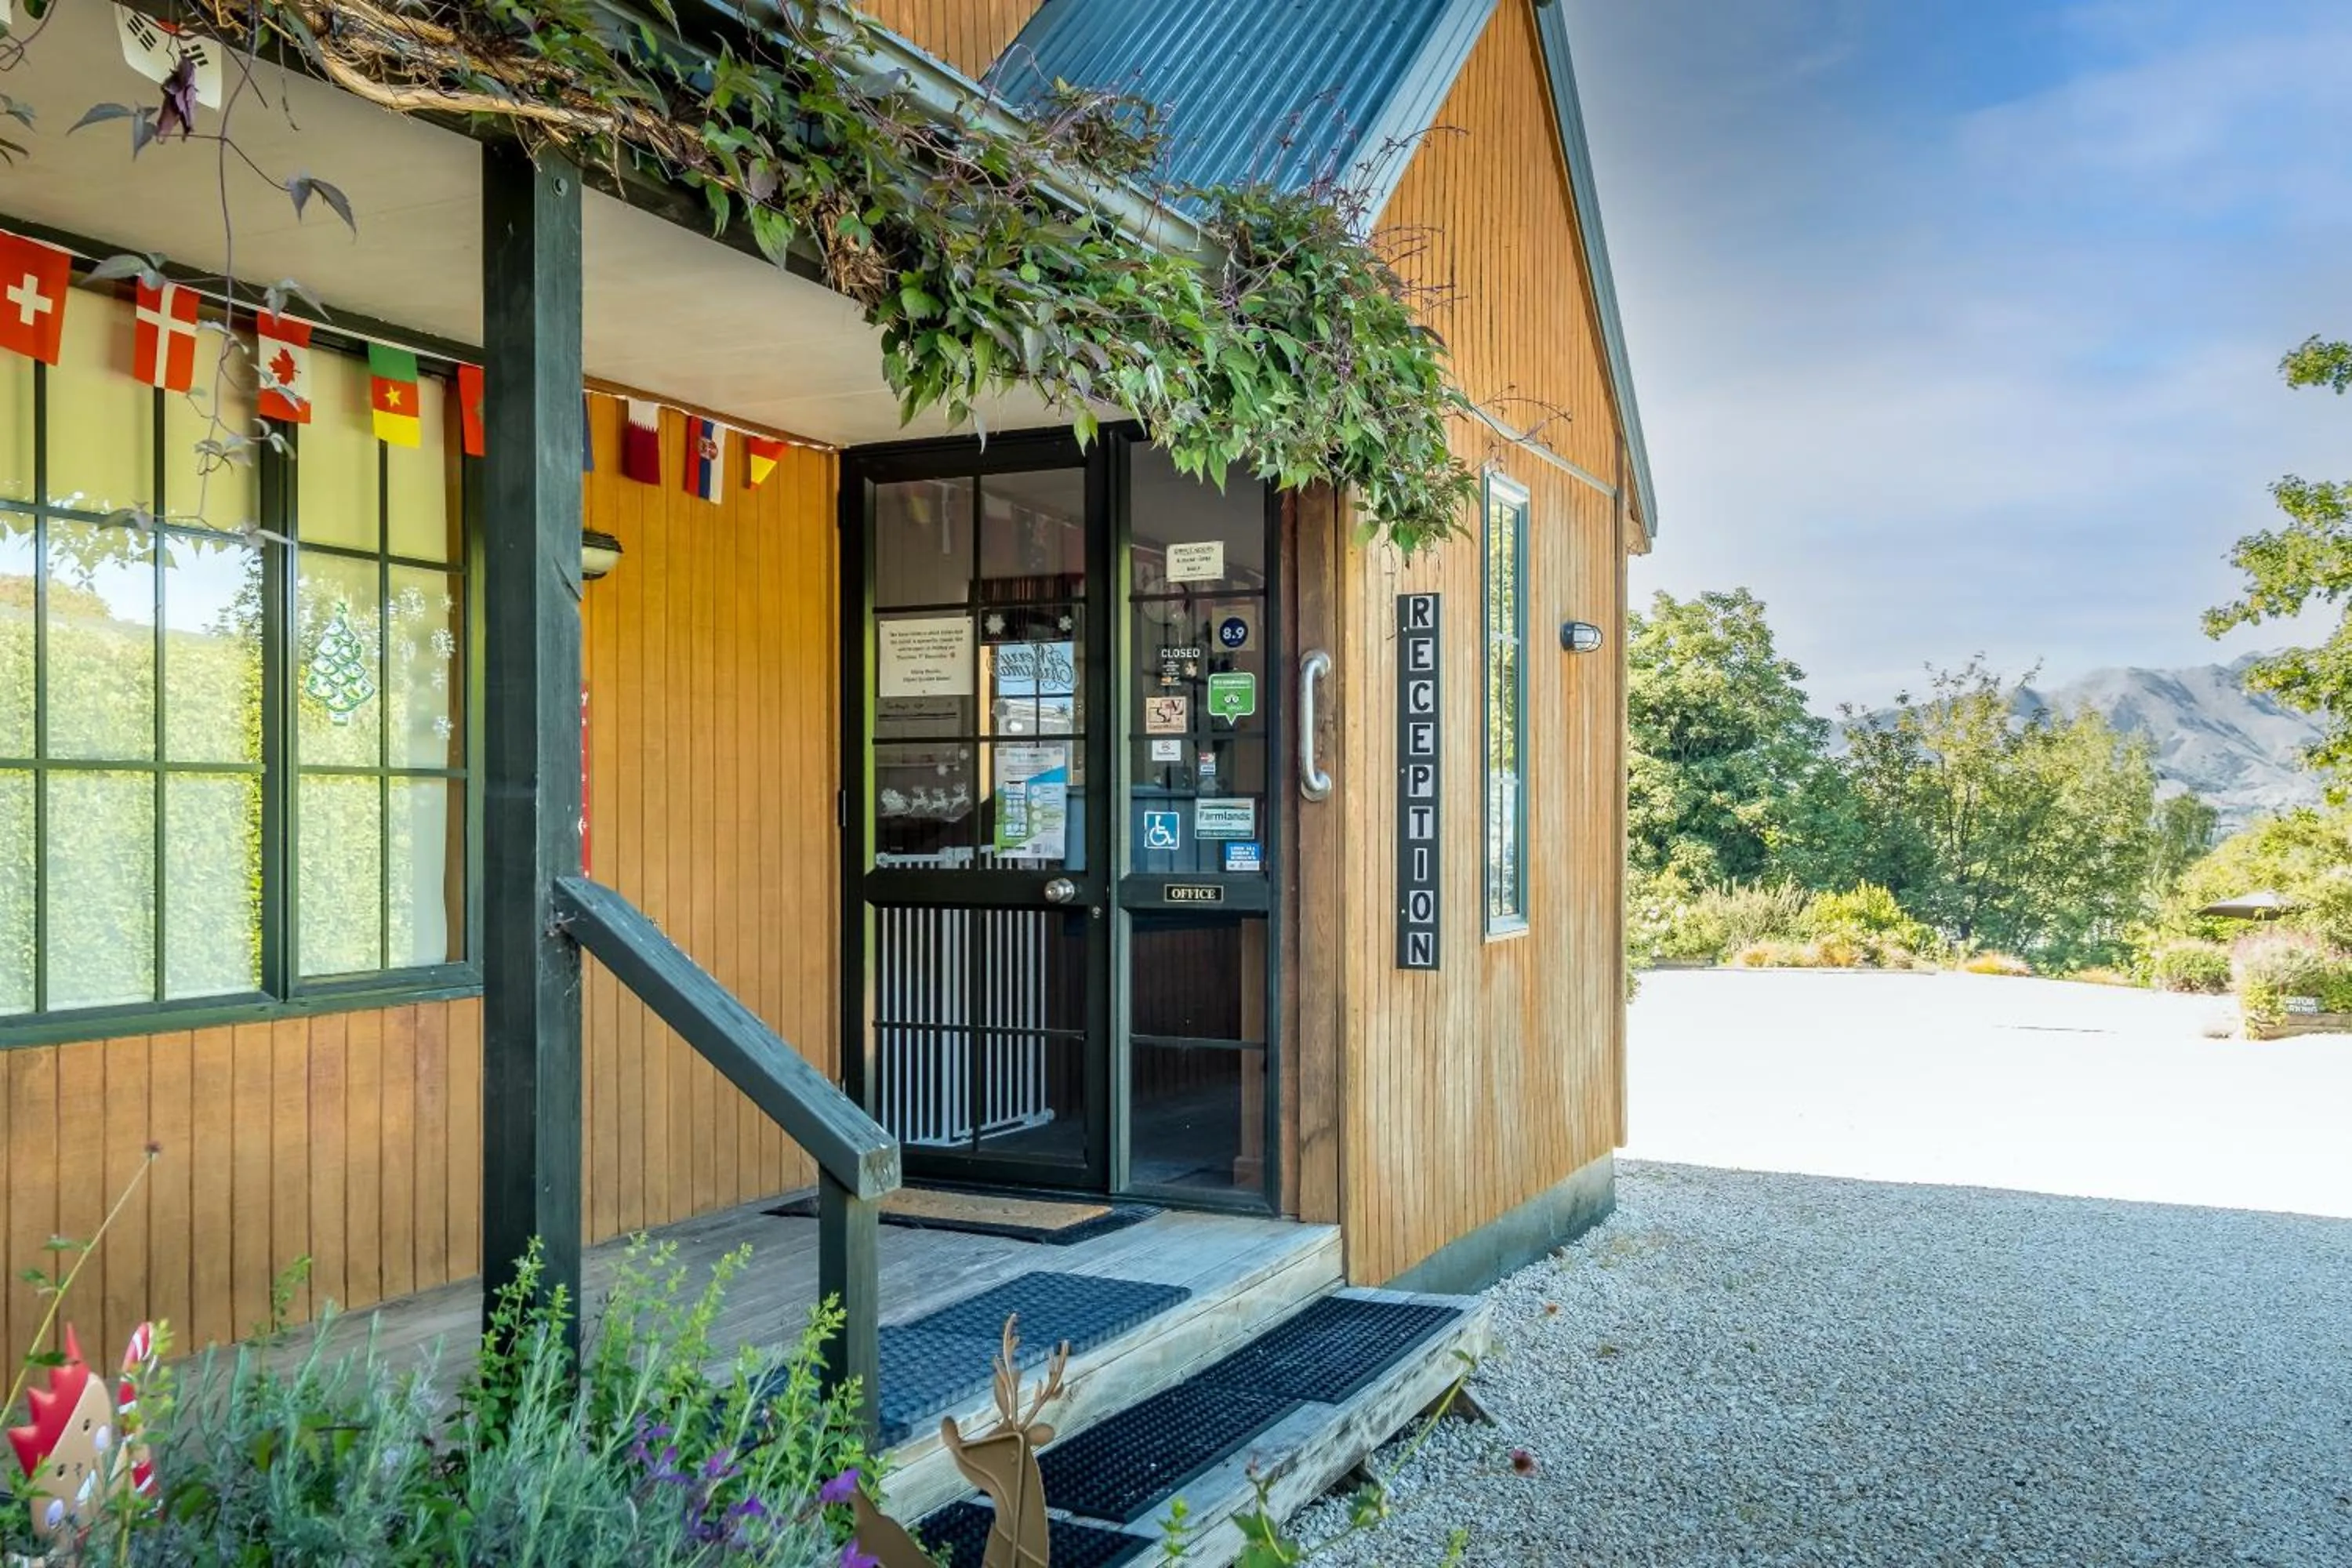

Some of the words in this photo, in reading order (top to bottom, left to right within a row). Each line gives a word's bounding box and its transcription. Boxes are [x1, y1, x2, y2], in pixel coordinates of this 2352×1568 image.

[1222, 626, 1245, 640] 8.9
[1161, 648, 1200, 658] CLOSED
[1410, 597, 1432, 964] RECEPTION
[1199, 811, 1250, 821] Farmlands
[1171, 888, 1216, 899] OFFICE
